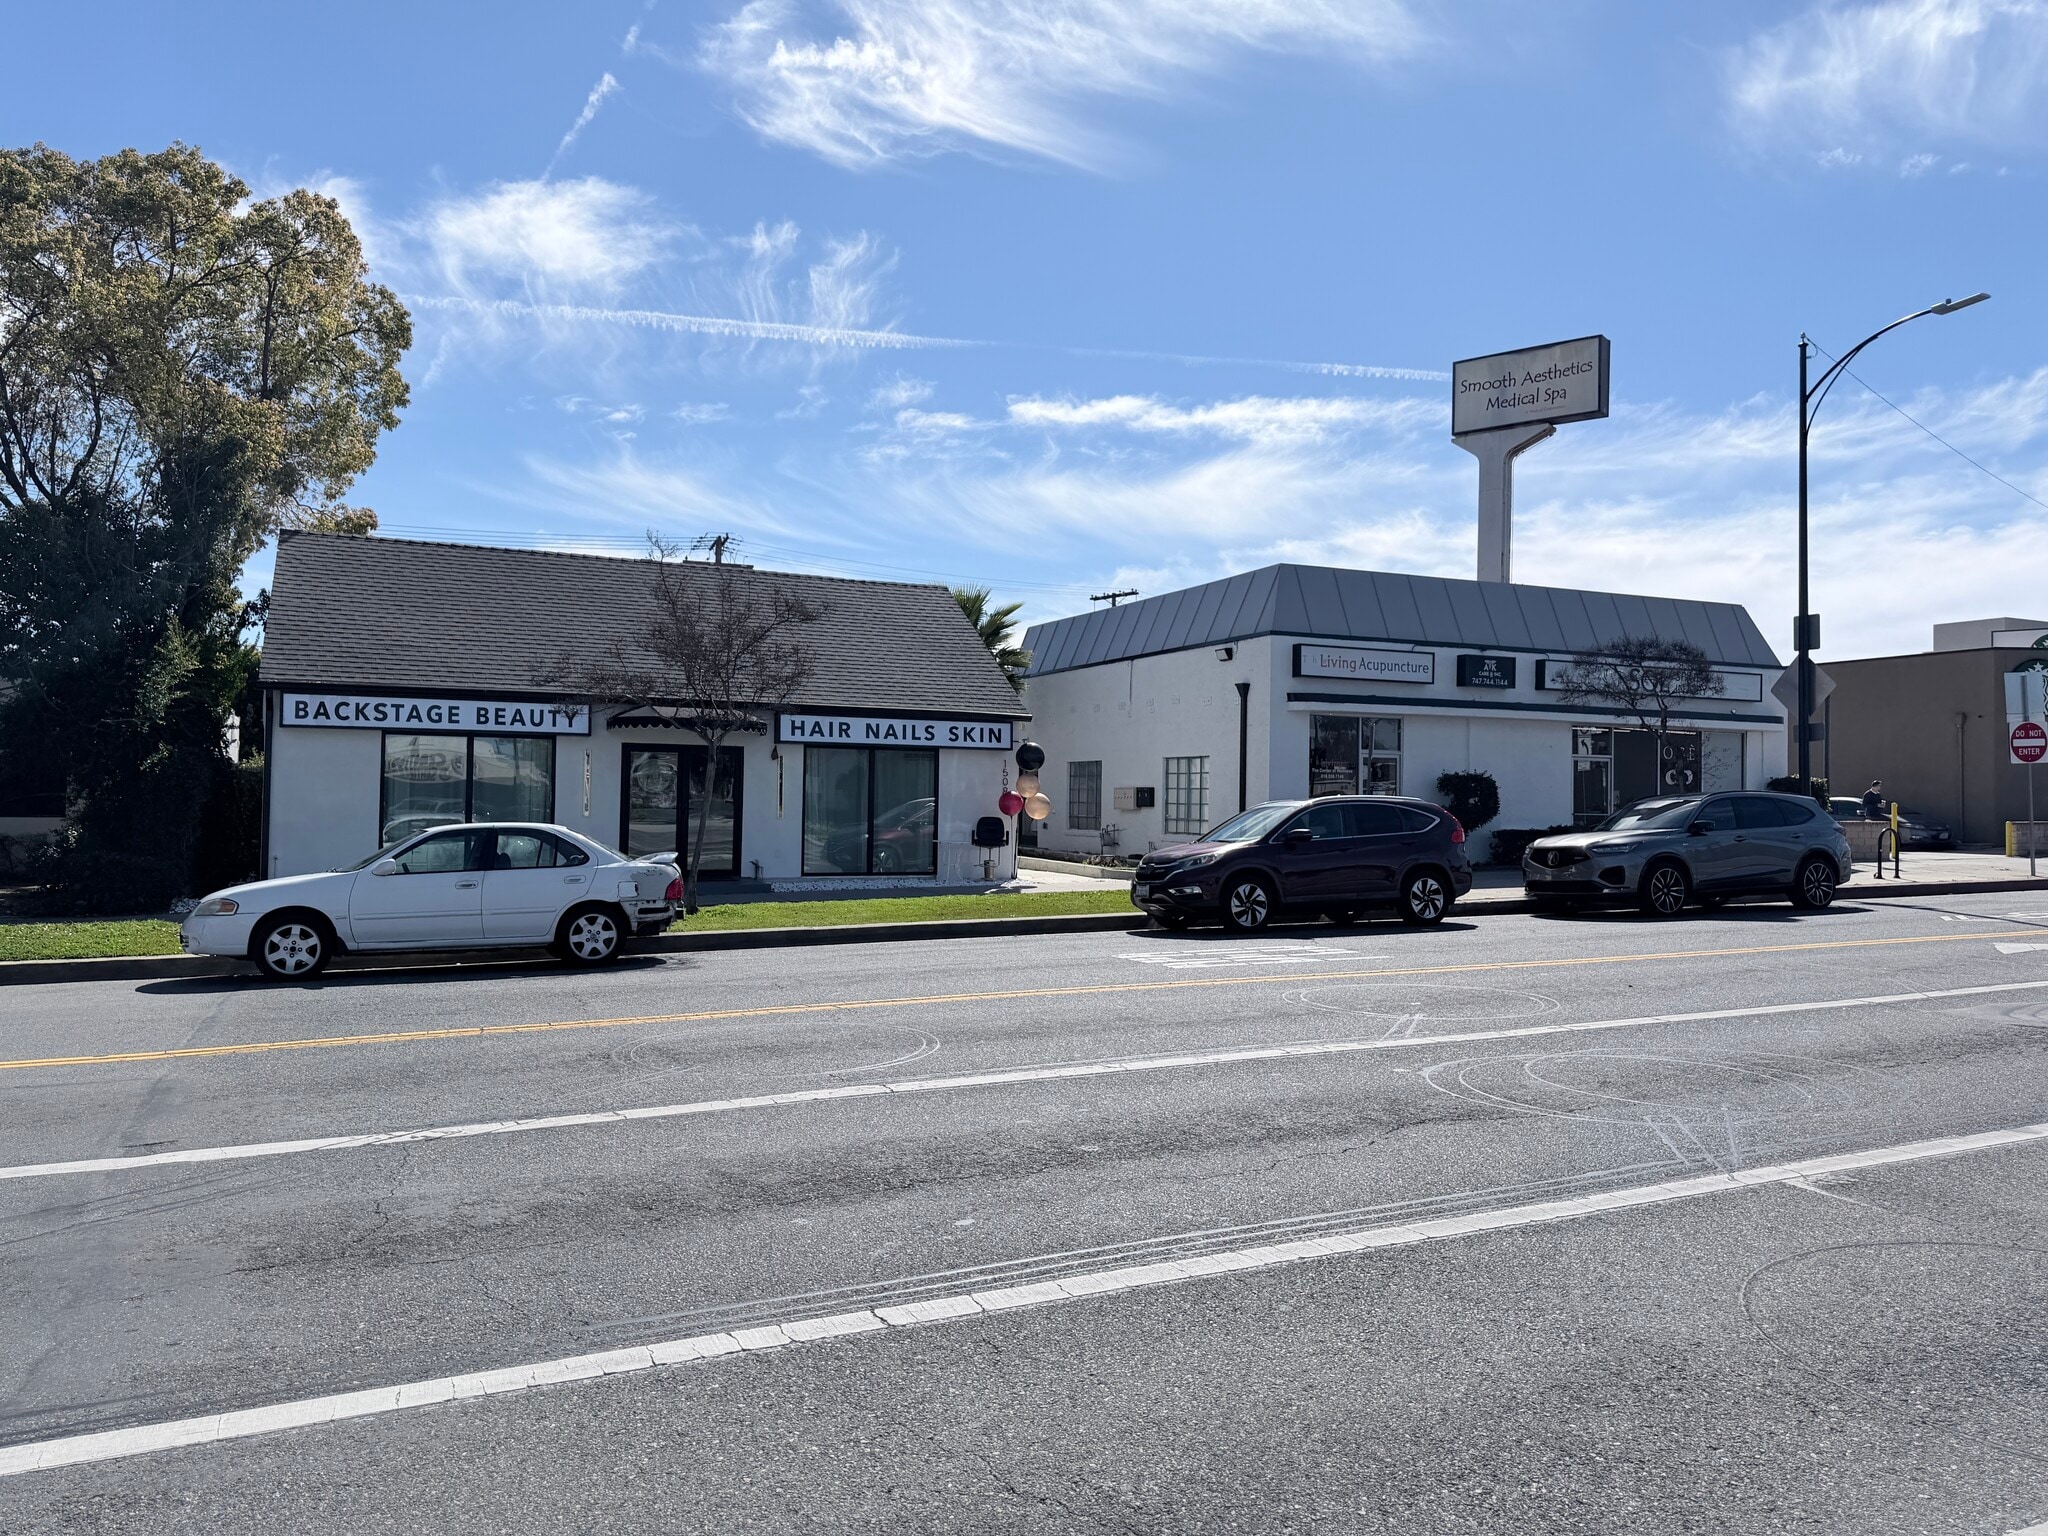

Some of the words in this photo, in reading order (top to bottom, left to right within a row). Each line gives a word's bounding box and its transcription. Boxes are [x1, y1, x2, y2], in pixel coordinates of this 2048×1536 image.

[1460, 371, 1517, 394] Smooth
[1520, 360, 1593, 387] Aesthetics
[1486, 387, 1540, 411] Medical
[1544, 388, 1567, 404] Spa
[1320, 654, 1357, 673] Living
[1359, 657, 1430, 674] Acupuncture
[294, 700, 461, 724] BACKSTAGE
[476, 706, 578, 728] BEAUTY
[789, 719, 851, 738] HAIR
[865, 722, 936, 740] NAILS
[948, 726, 1003, 744] SKIN
